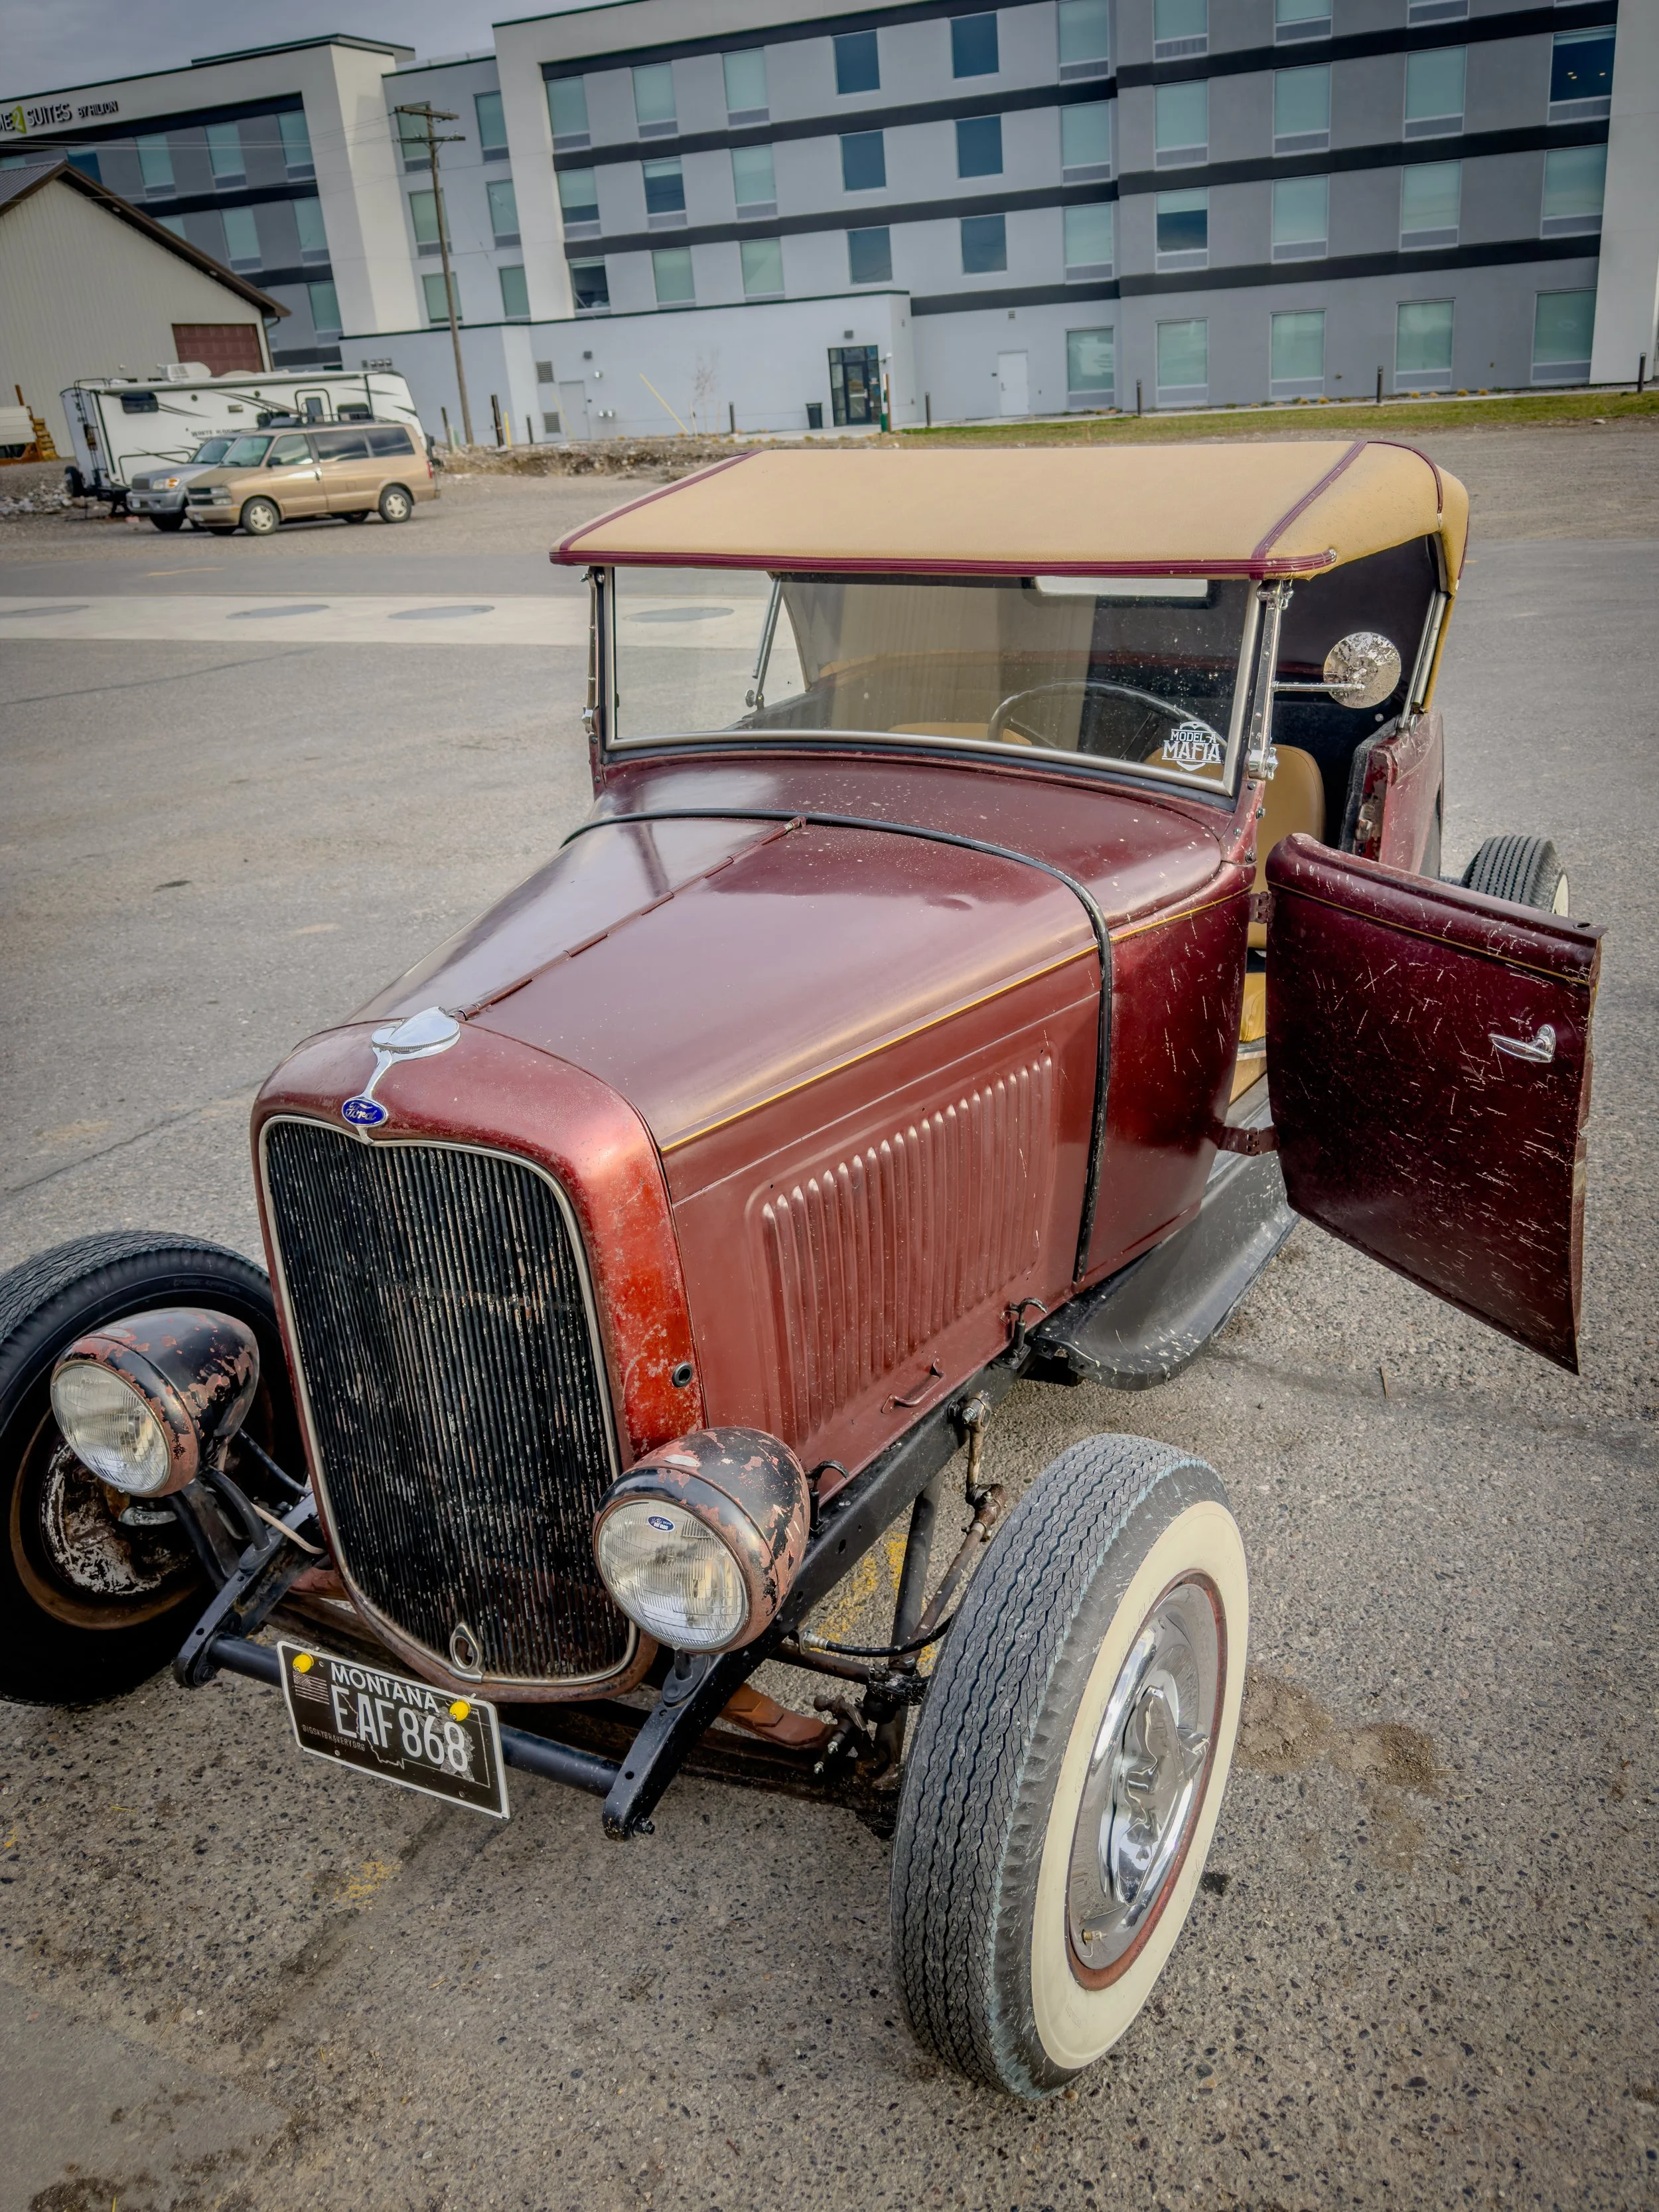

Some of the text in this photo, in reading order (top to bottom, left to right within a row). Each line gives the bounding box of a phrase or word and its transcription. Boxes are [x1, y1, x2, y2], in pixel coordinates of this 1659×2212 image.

[26, 103, 72, 126] SUITES
[77, 106, 88, 117] BY
[89, 100, 119, 115] HILTON
[1170, 731, 1216, 743] MODEL A
[1162, 740, 1221, 761] MAFIA
[345, 1102, 378, 1121] Ford
[330, 1662, 439, 1713] MONTANA
[302, 1724, 366, 1751] BIGSKYBRAVERY.ORG
[330, 1684, 468, 1773] EAF 868
